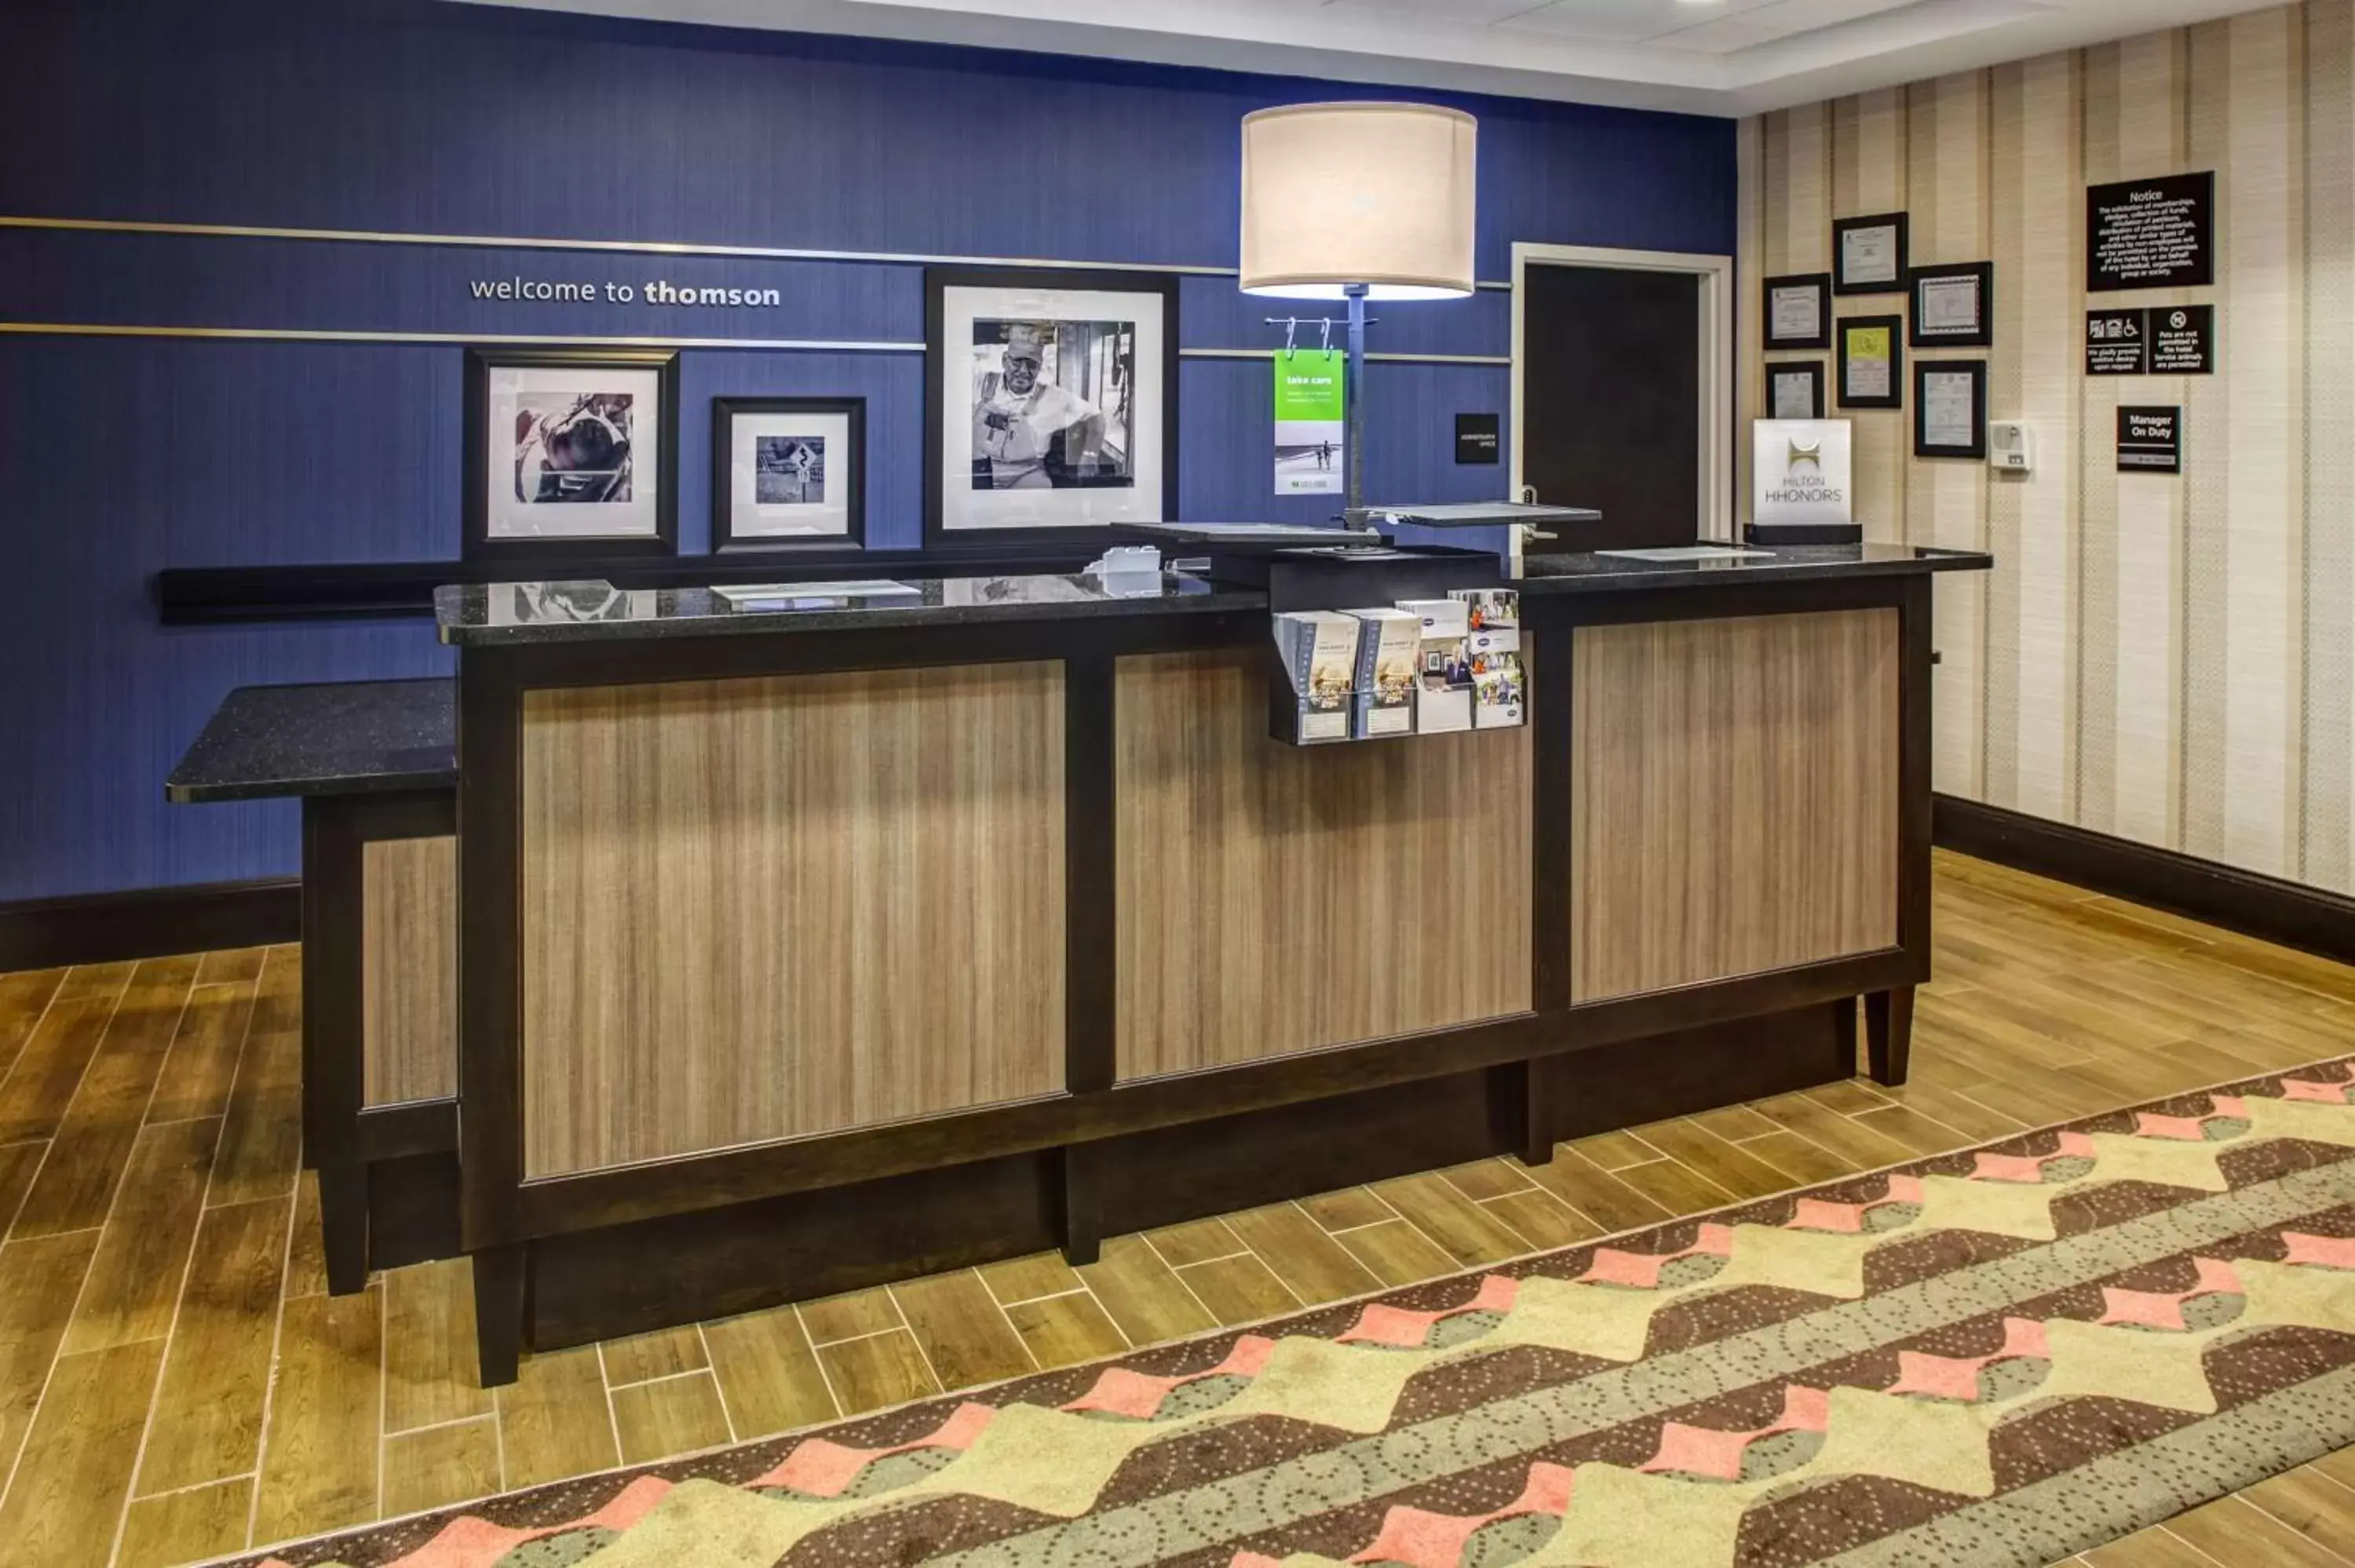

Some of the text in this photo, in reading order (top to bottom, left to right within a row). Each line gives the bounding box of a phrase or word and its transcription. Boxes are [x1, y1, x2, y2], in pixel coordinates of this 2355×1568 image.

[2130, 189, 2163, 202] Notice
[470, 277, 781, 307] welcome to thomson
[2185, 330, 2198, 338] not
[2117, 347, 2141, 358] provide
[1287, 376, 1309, 385] take
[2129, 414, 2172, 428] Manager
[2131, 426, 2172, 439] On Duty
[1783, 476, 1825, 487] HILTON
[1765, 488, 1842, 503] HHONORS
